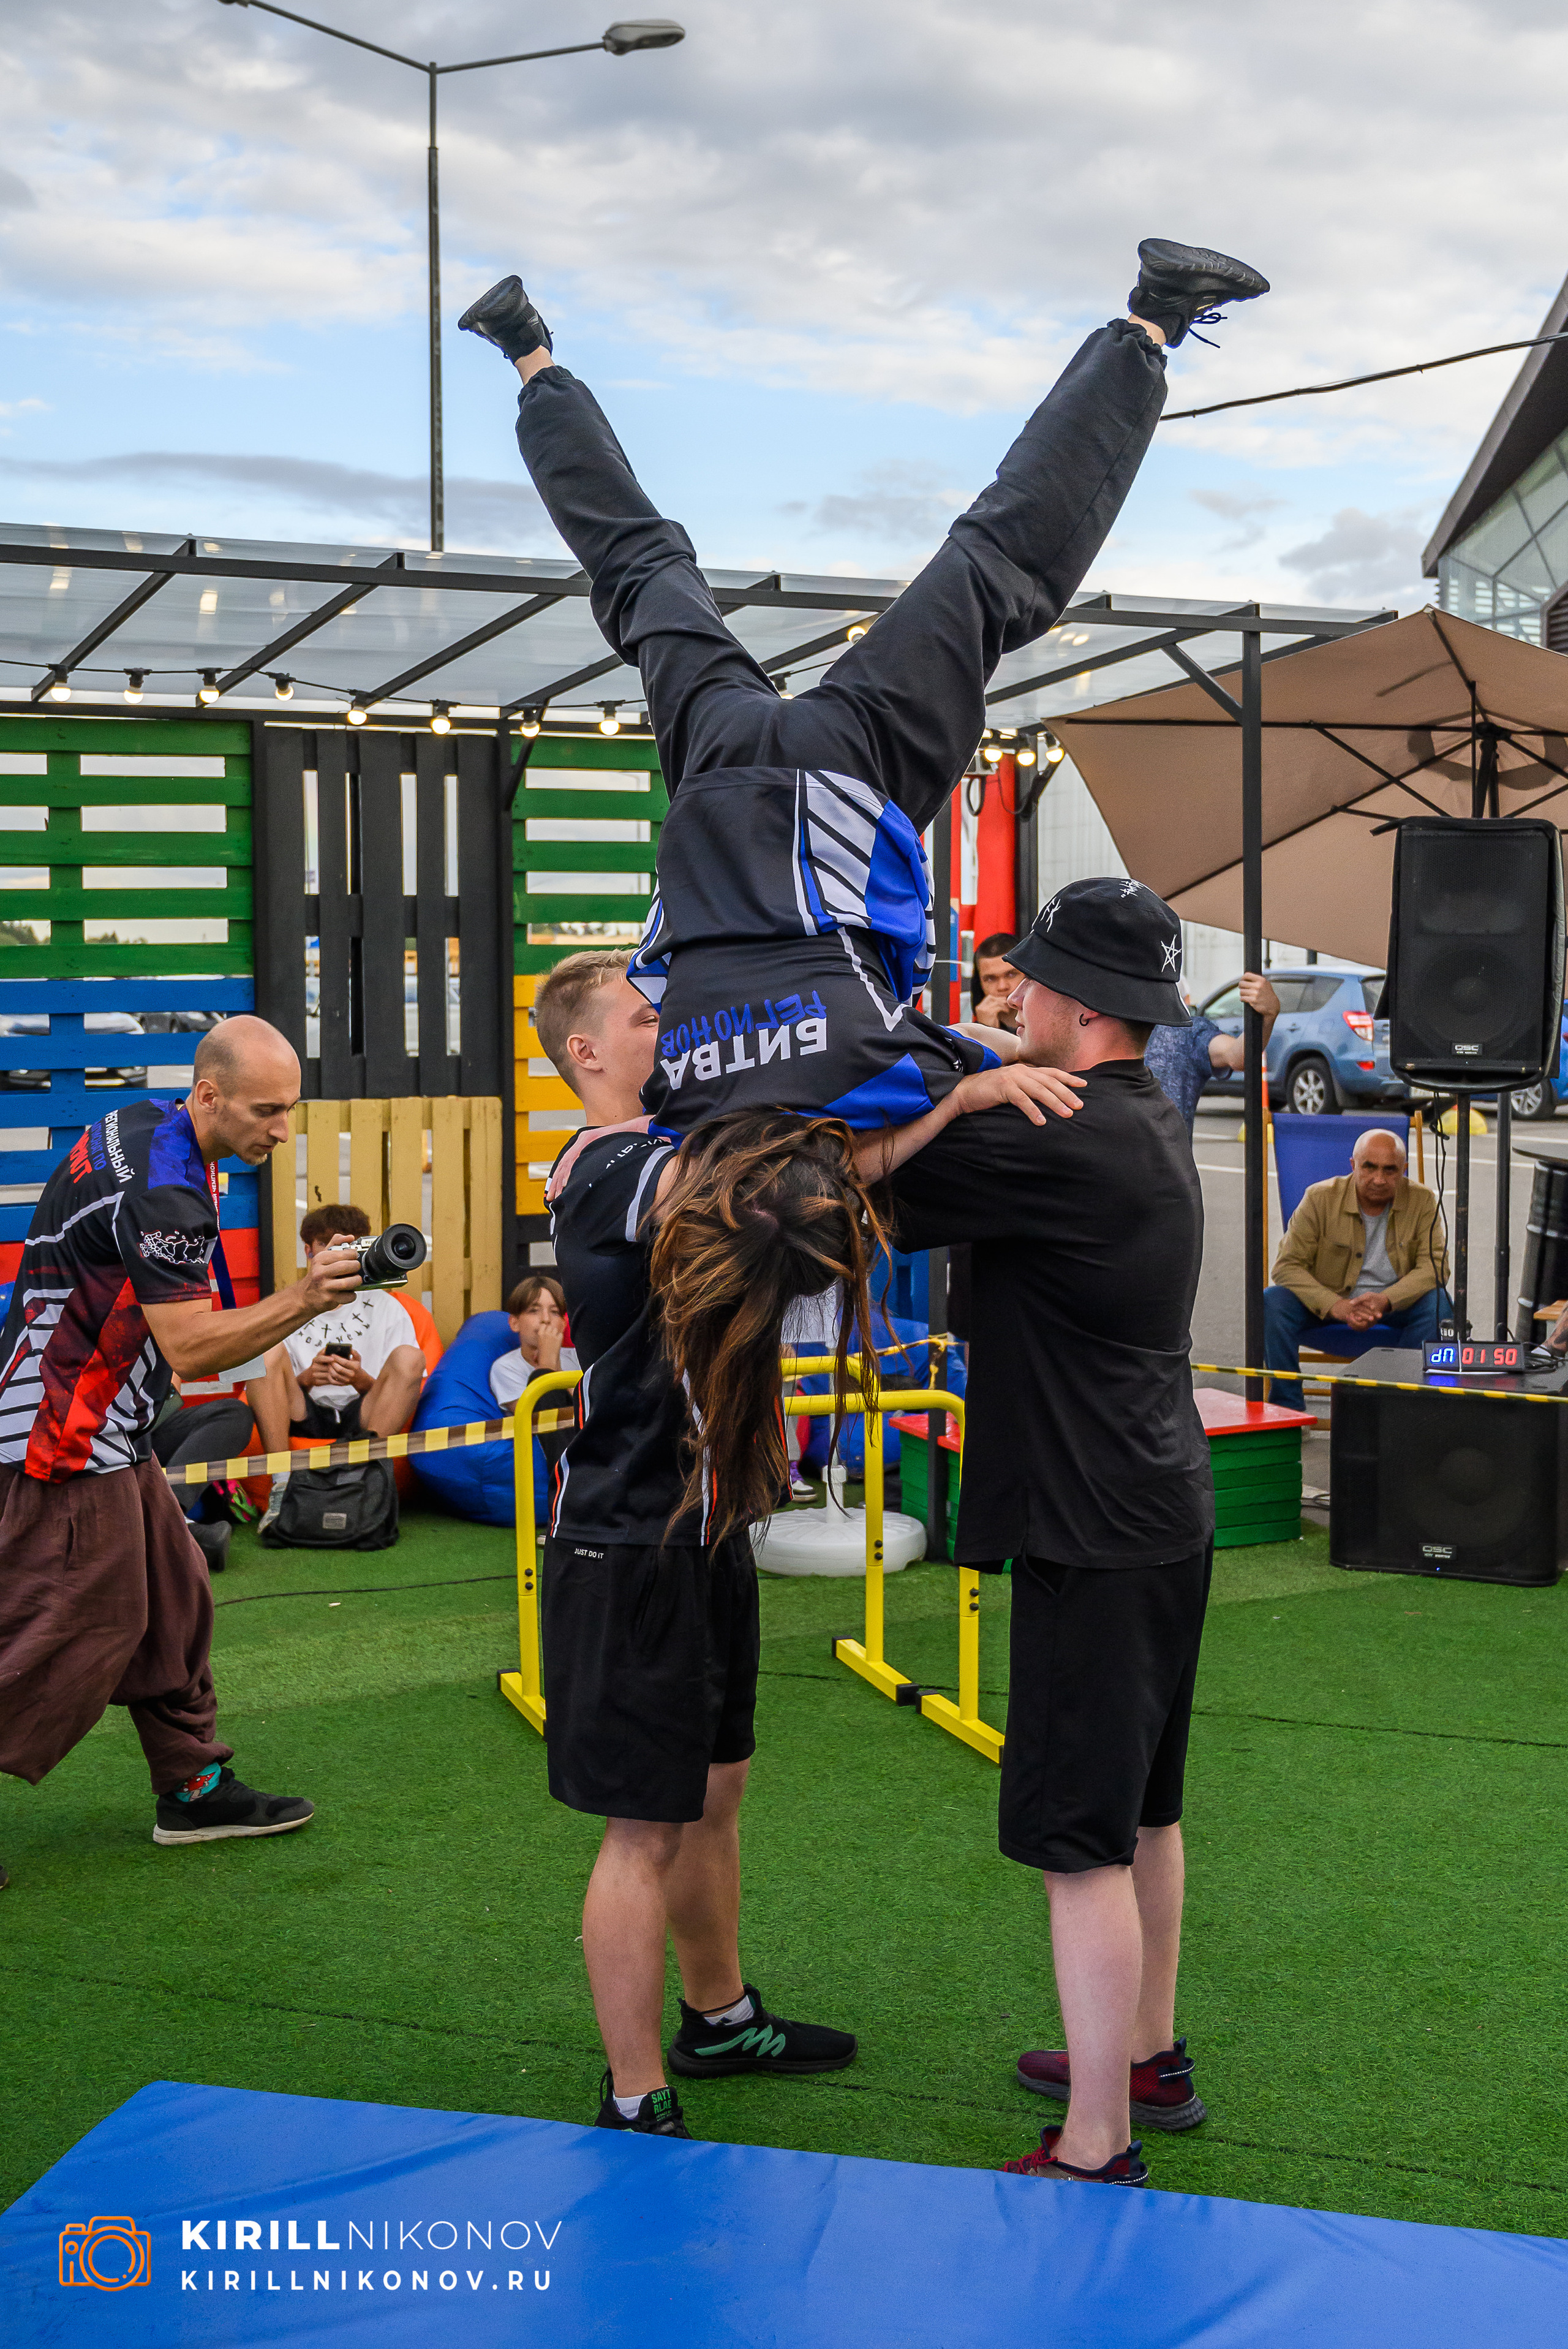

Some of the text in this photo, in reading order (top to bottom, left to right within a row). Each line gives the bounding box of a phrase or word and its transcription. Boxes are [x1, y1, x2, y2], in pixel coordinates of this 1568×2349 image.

[660, 990, 827, 1057] РЕГИОНОВ
[660, 1017, 827, 1090] БИТВА
[105, 1109, 135, 1183] РЕГИОНАЛЬНЫЙ
[574, 1548, 588, 1556] JUST
[651, 2089, 671, 2103] SAYT
